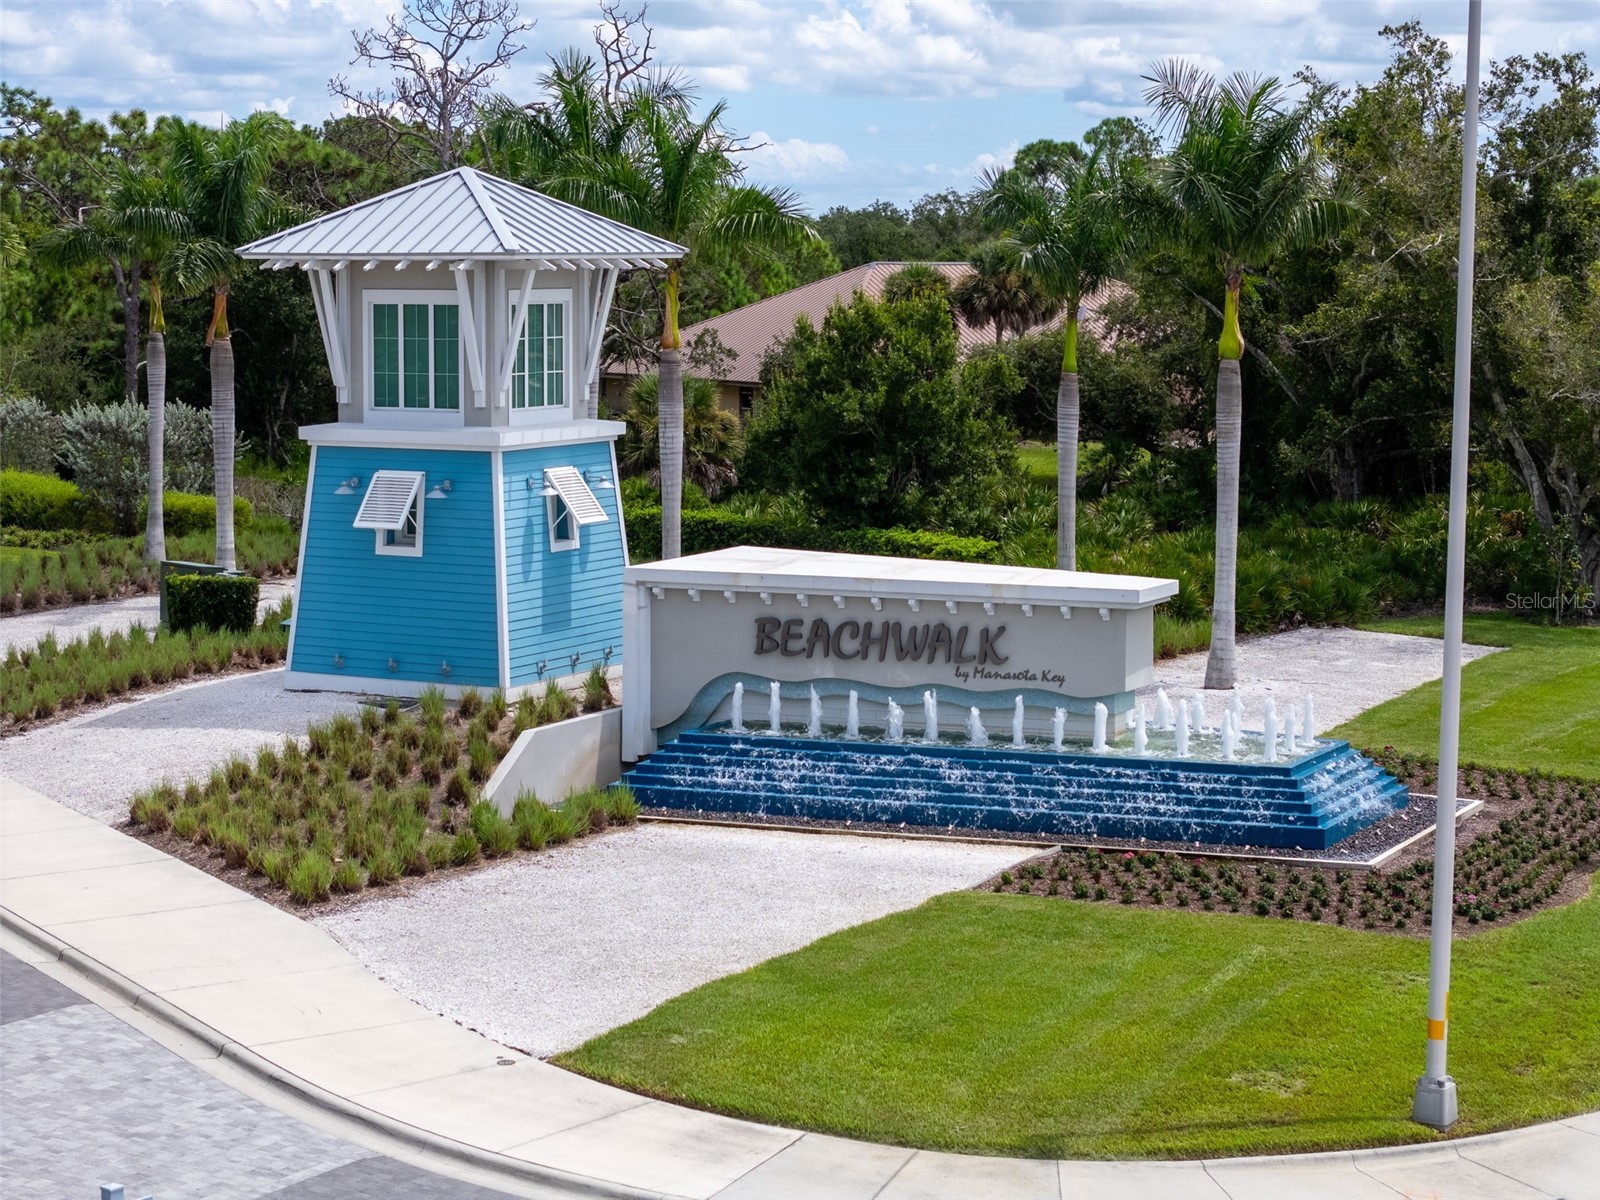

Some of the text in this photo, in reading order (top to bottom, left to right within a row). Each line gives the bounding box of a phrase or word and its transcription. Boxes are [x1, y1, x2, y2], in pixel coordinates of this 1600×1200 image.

[754, 617, 1009, 665] BEACHWALK
[954, 665, 1066, 688] by Manasota Key
